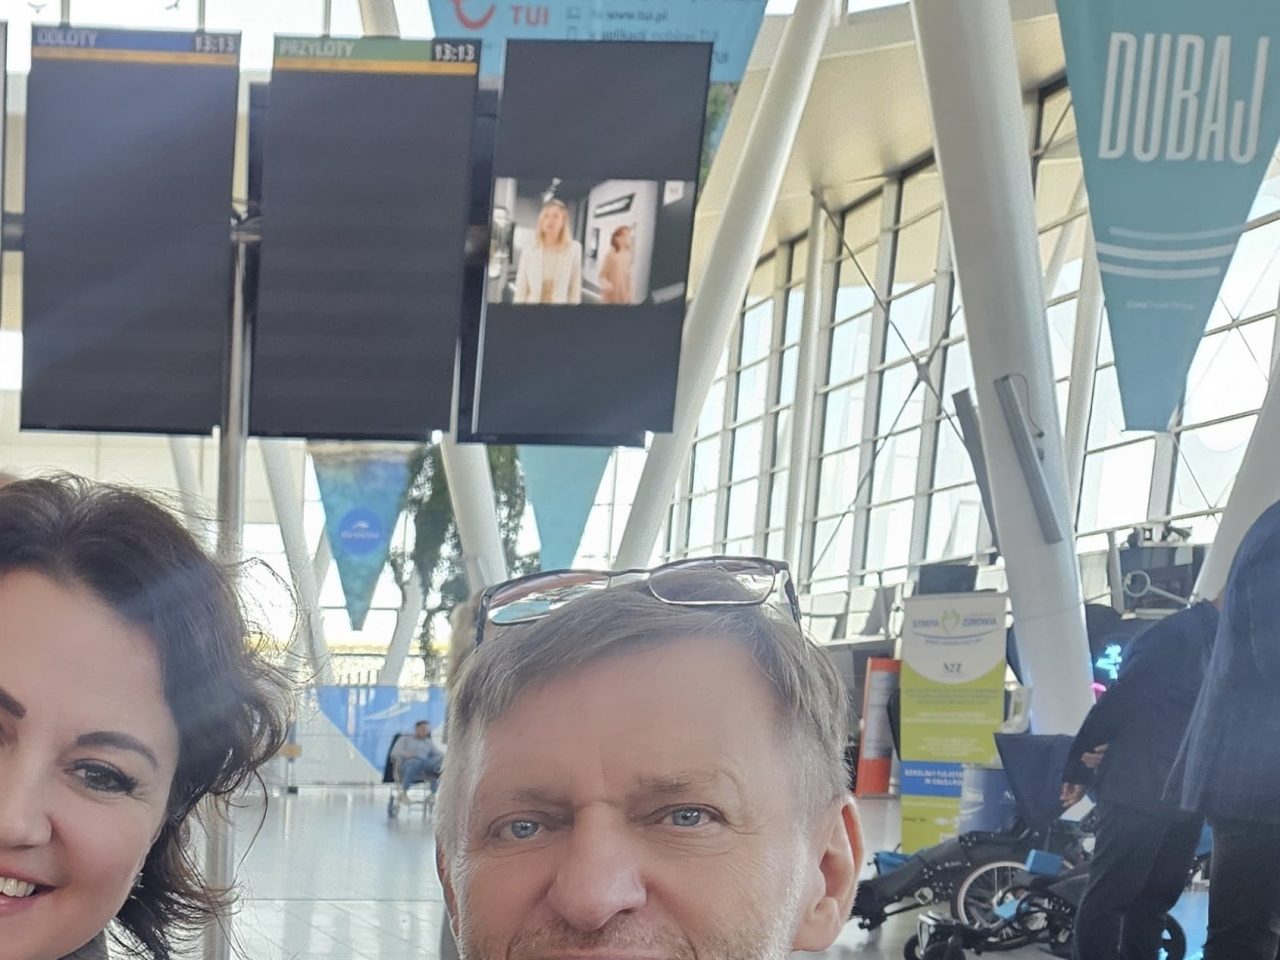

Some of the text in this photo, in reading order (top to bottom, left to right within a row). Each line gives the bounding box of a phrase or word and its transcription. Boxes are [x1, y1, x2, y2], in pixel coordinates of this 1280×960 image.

[511, 5, 550, 26] TUI
[37, 29, 236, 54] ODLOTY 13:13
[434, 44, 475, 61] 13:13
[1098, 31, 1270, 164] DUBAJ
